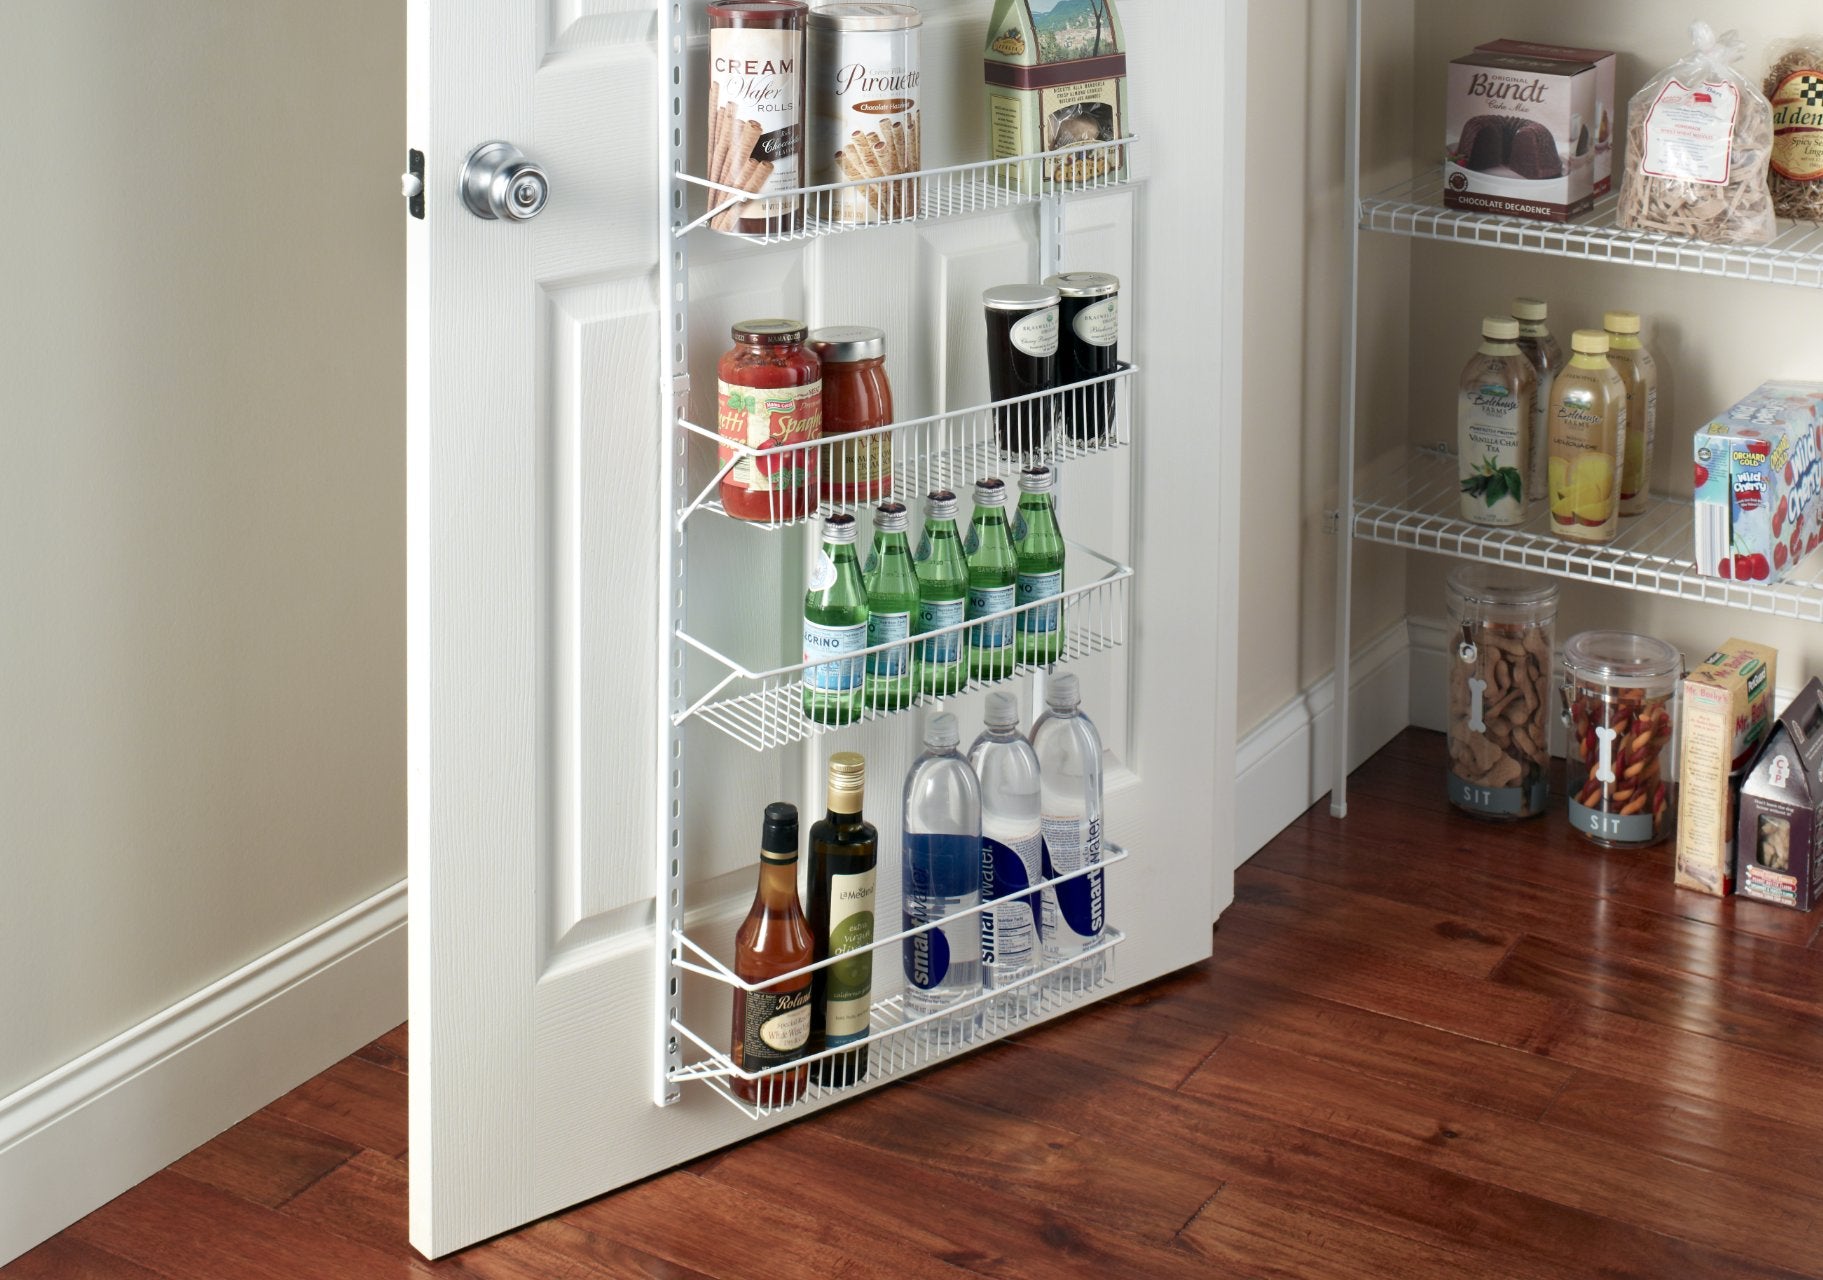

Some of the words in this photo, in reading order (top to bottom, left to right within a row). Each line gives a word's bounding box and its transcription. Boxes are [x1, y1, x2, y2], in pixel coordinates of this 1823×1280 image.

[715, 57, 793, 75] CREAM
[836, 63, 920, 96] Pirouette
[1492, 75, 1527, 84] ORIGINAL
[727, 77, 781, 107] Wafer
[1468, 72, 1548, 104] Bundt
[758, 104, 793, 112] ROLLS
[860, 102, 888, 113] Chocolate
[1487, 99, 1506, 111] Cake
[1774, 107, 1786, 125] al
[1792, 136, 1811, 149] Spicy
[1458, 196, 1503, 209] CHOCOLATE
[1505, 203, 1551, 215] DECADENCE
[1475, 397, 1519, 410] Bolthouse
[1482, 405, 1507, 414] FARMS
[1556, 409, 1601, 425] Bolthouse
[1469, 434, 1499, 445] VANILLA
[1500, 437, 1518, 447] CHAI
[1486, 445, 1500, 453] TEA
[1789, 424, 1816, 486] Wild
[1733, 451, 1765, 463] ORCHARD
[1740, 459, 1759, 467] GOLD
[1737, 472, 1761, 483] Wild
[1734, 481, 1767, 493] Cherry
[1788, 458, 1822, 524] Cherry
[1776, 762, 1785, 771] C
[1775, 776, 1783, 786] P
[1464, 791, 1490, 806] SIT
[1590, 820, 1620, 839] SIT
